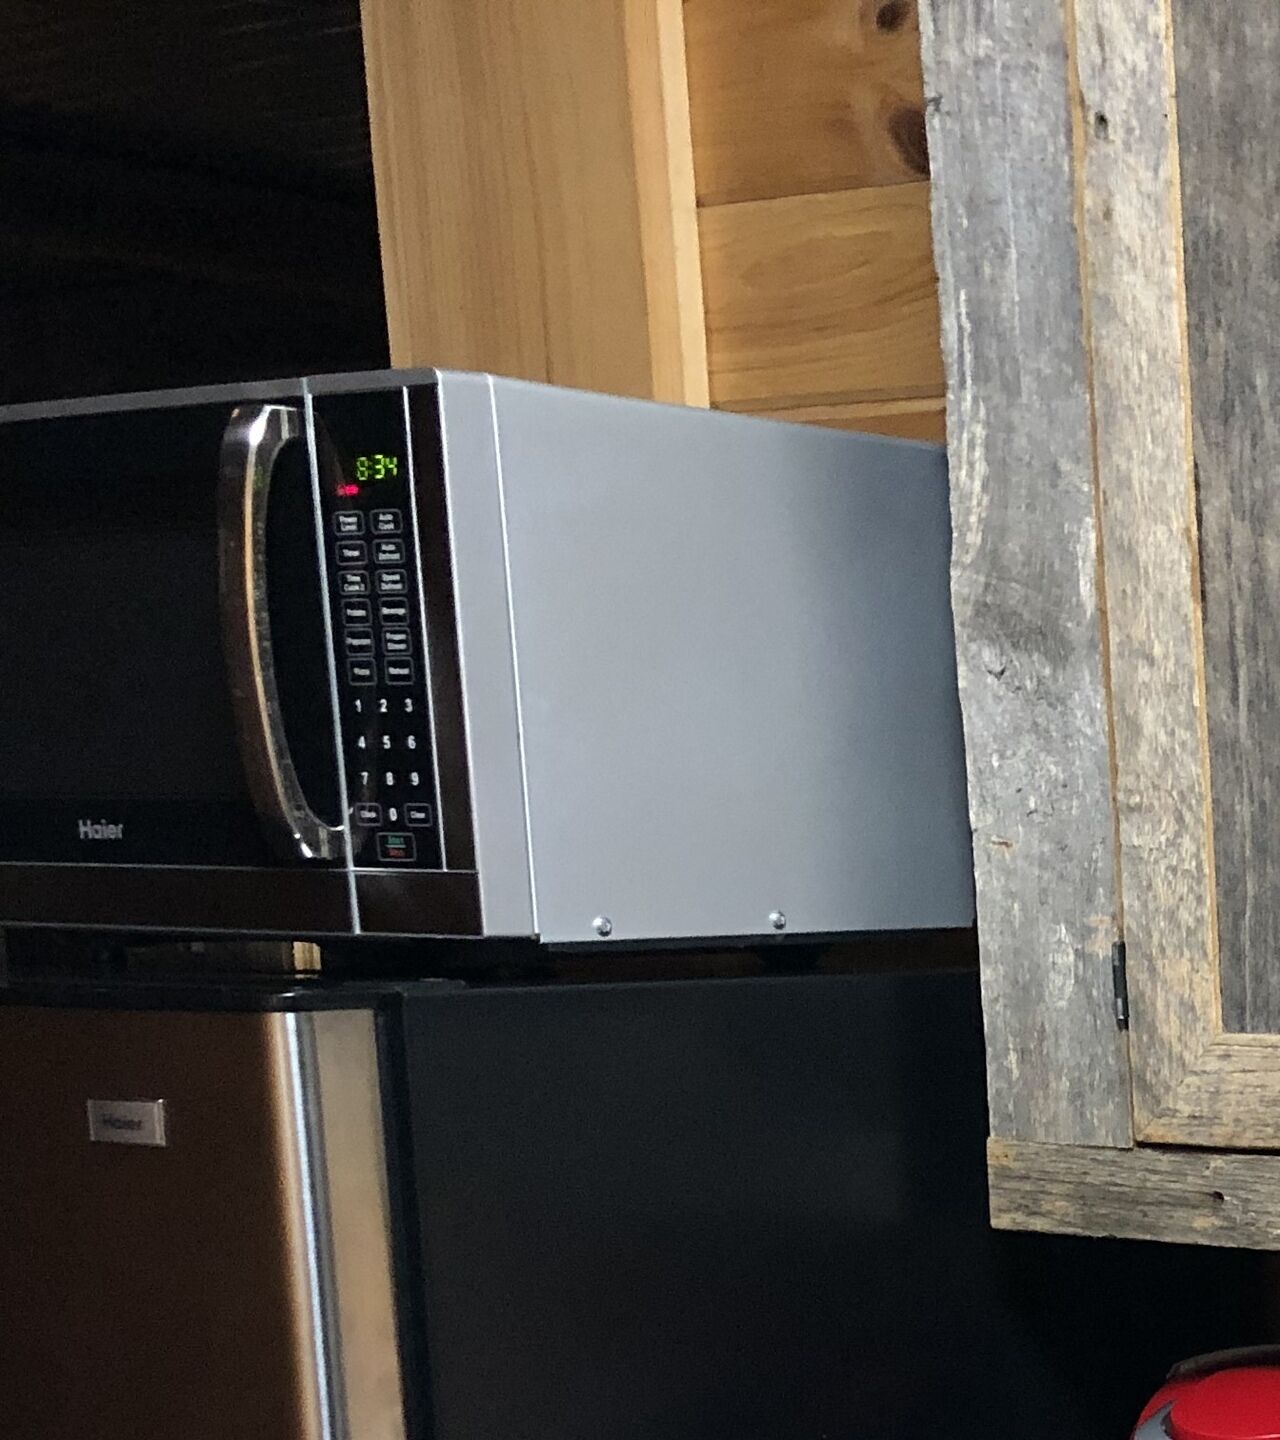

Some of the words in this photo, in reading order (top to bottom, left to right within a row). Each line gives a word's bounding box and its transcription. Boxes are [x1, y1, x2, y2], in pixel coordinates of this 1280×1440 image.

[355, 699, 362, 713] 1
[380, 698, 388, 713] 2
[404, 698, 413, 713] 3
[358, 735, 366, 749] 4
[383, 735, 392, 750] 5
[407, 735, 417, 749] 6
[360, 771, 369, 785] 7
[385, 771, 395, 786] 8
[410, 771, 419, 786] 9
[389, 807, 398, 821] 0
[78, 818, 125, 840] Haier
